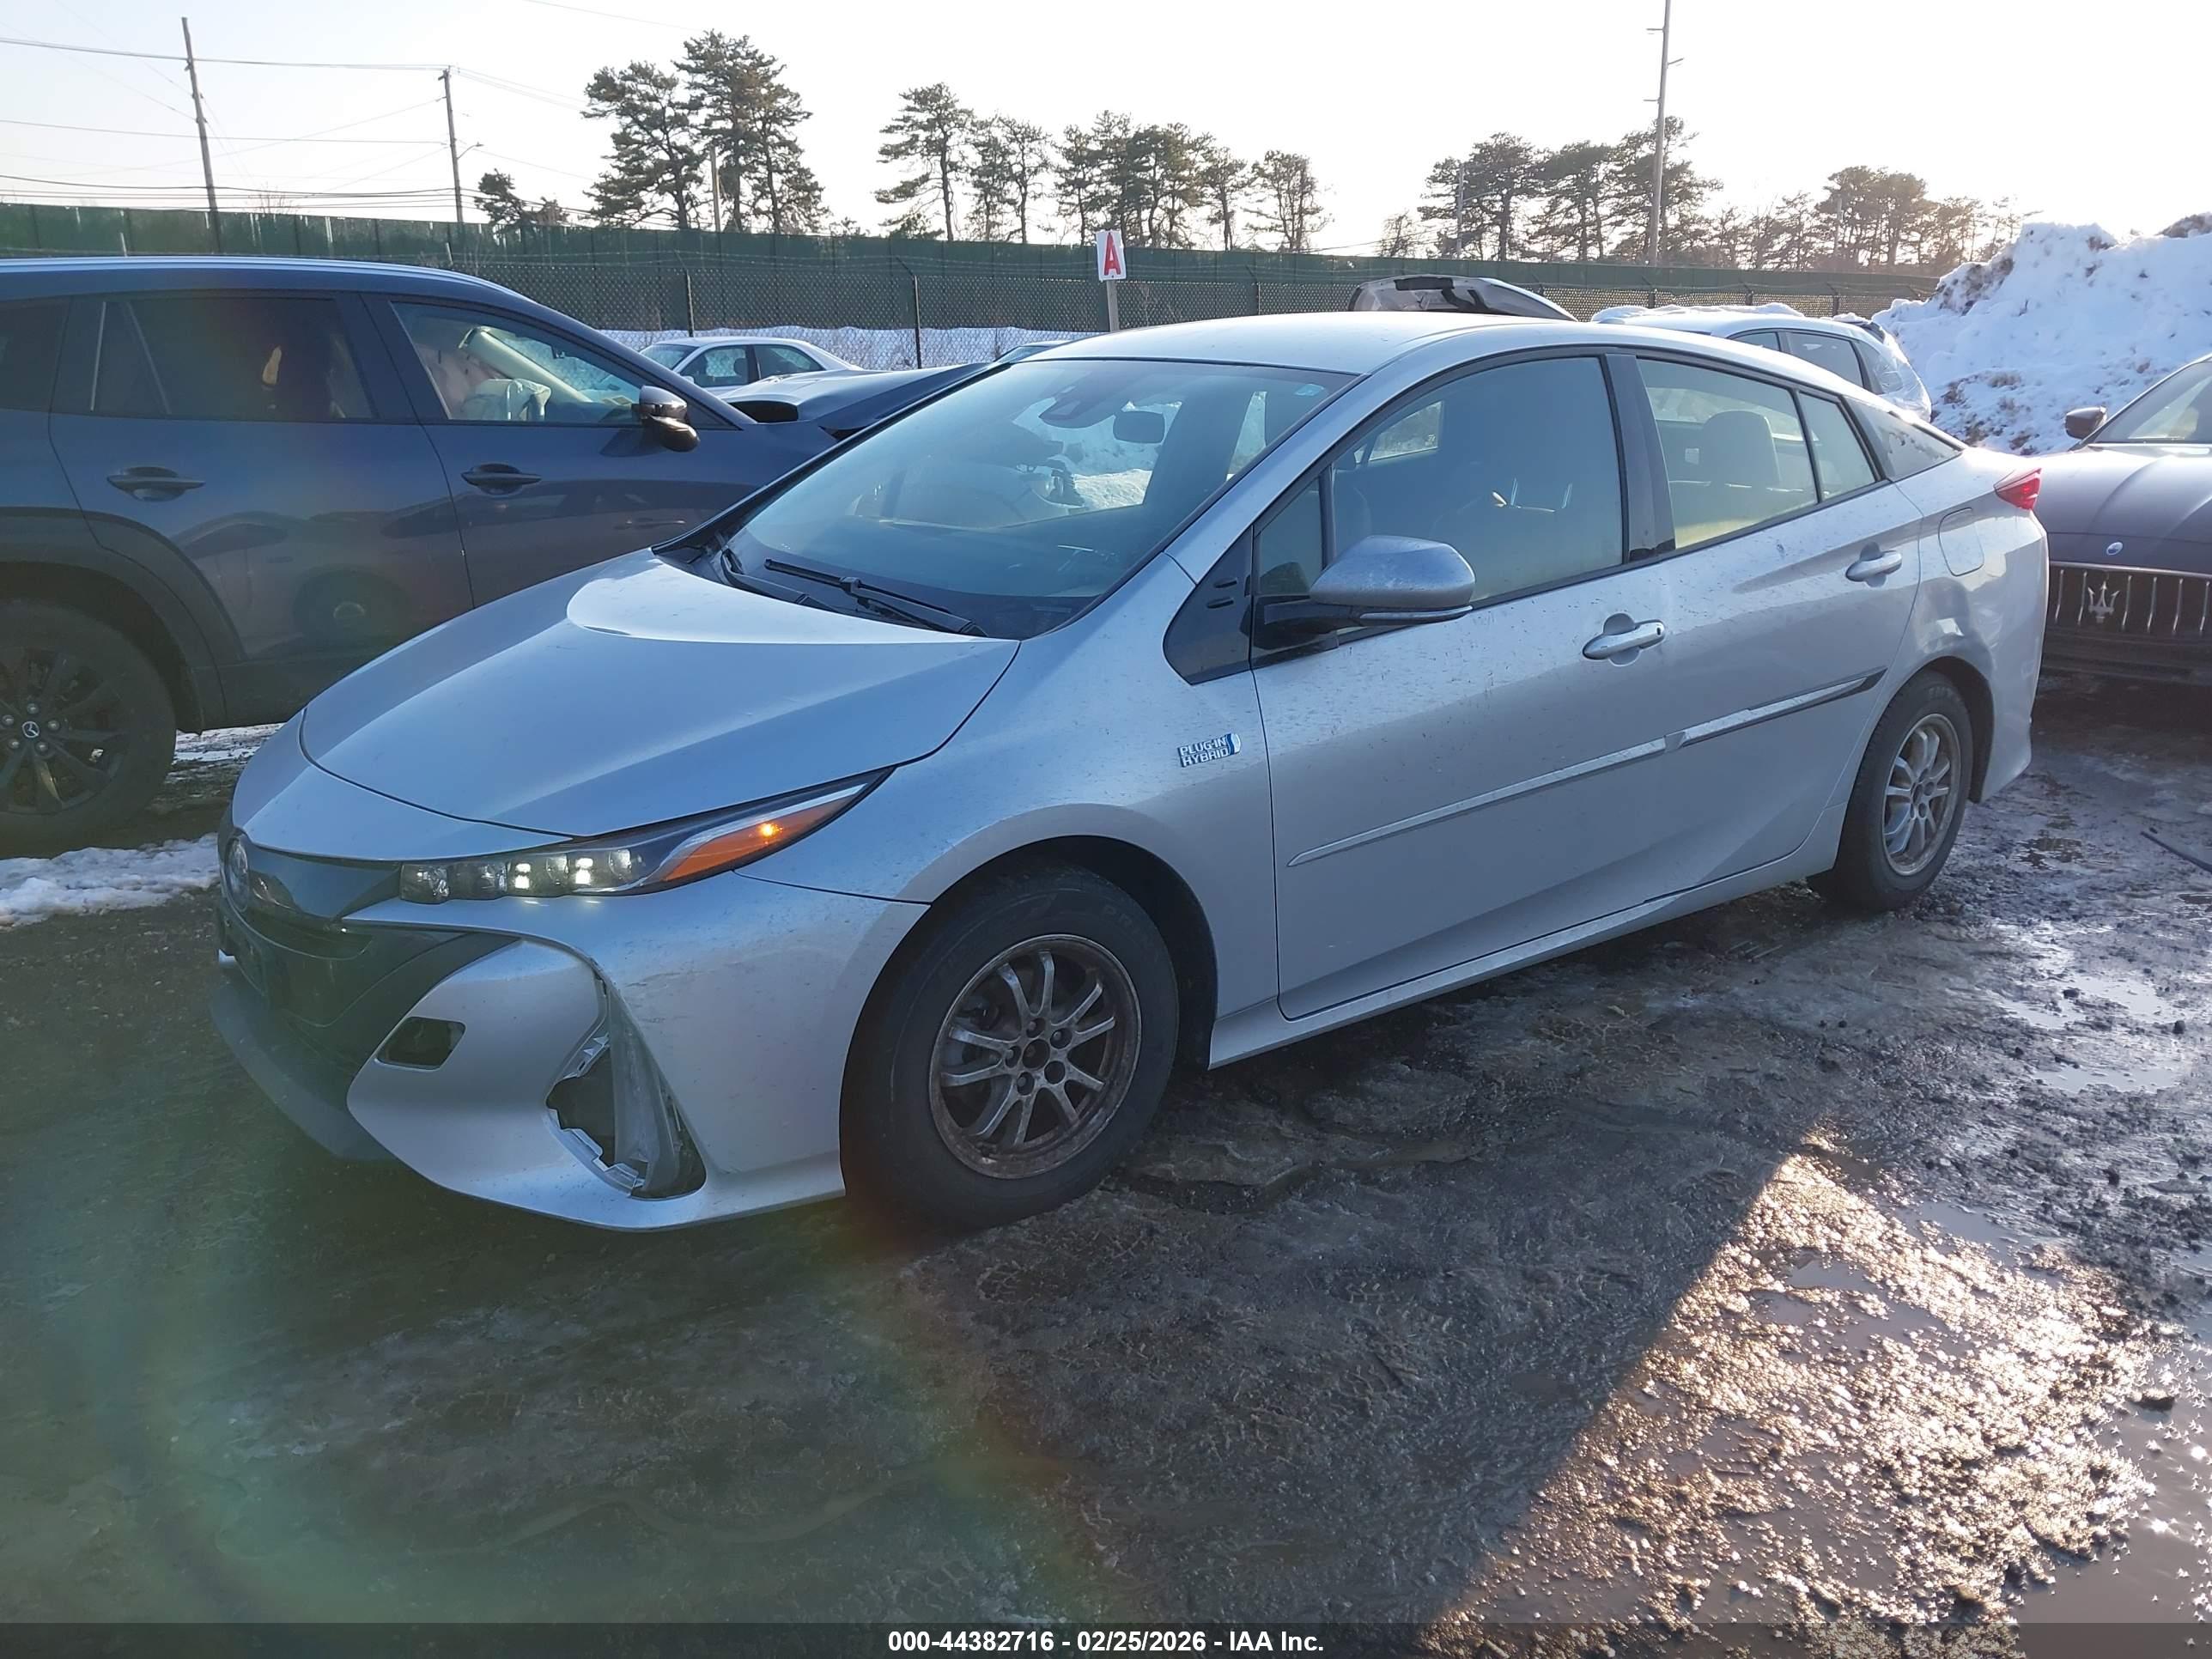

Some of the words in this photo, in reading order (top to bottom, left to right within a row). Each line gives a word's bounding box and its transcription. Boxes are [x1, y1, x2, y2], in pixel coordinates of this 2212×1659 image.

[1103, 232, 1121, 276] A
[1179, 736, 1227, 757] PLUG-IN
[1181, 747, 1229, 767] HYBRID
